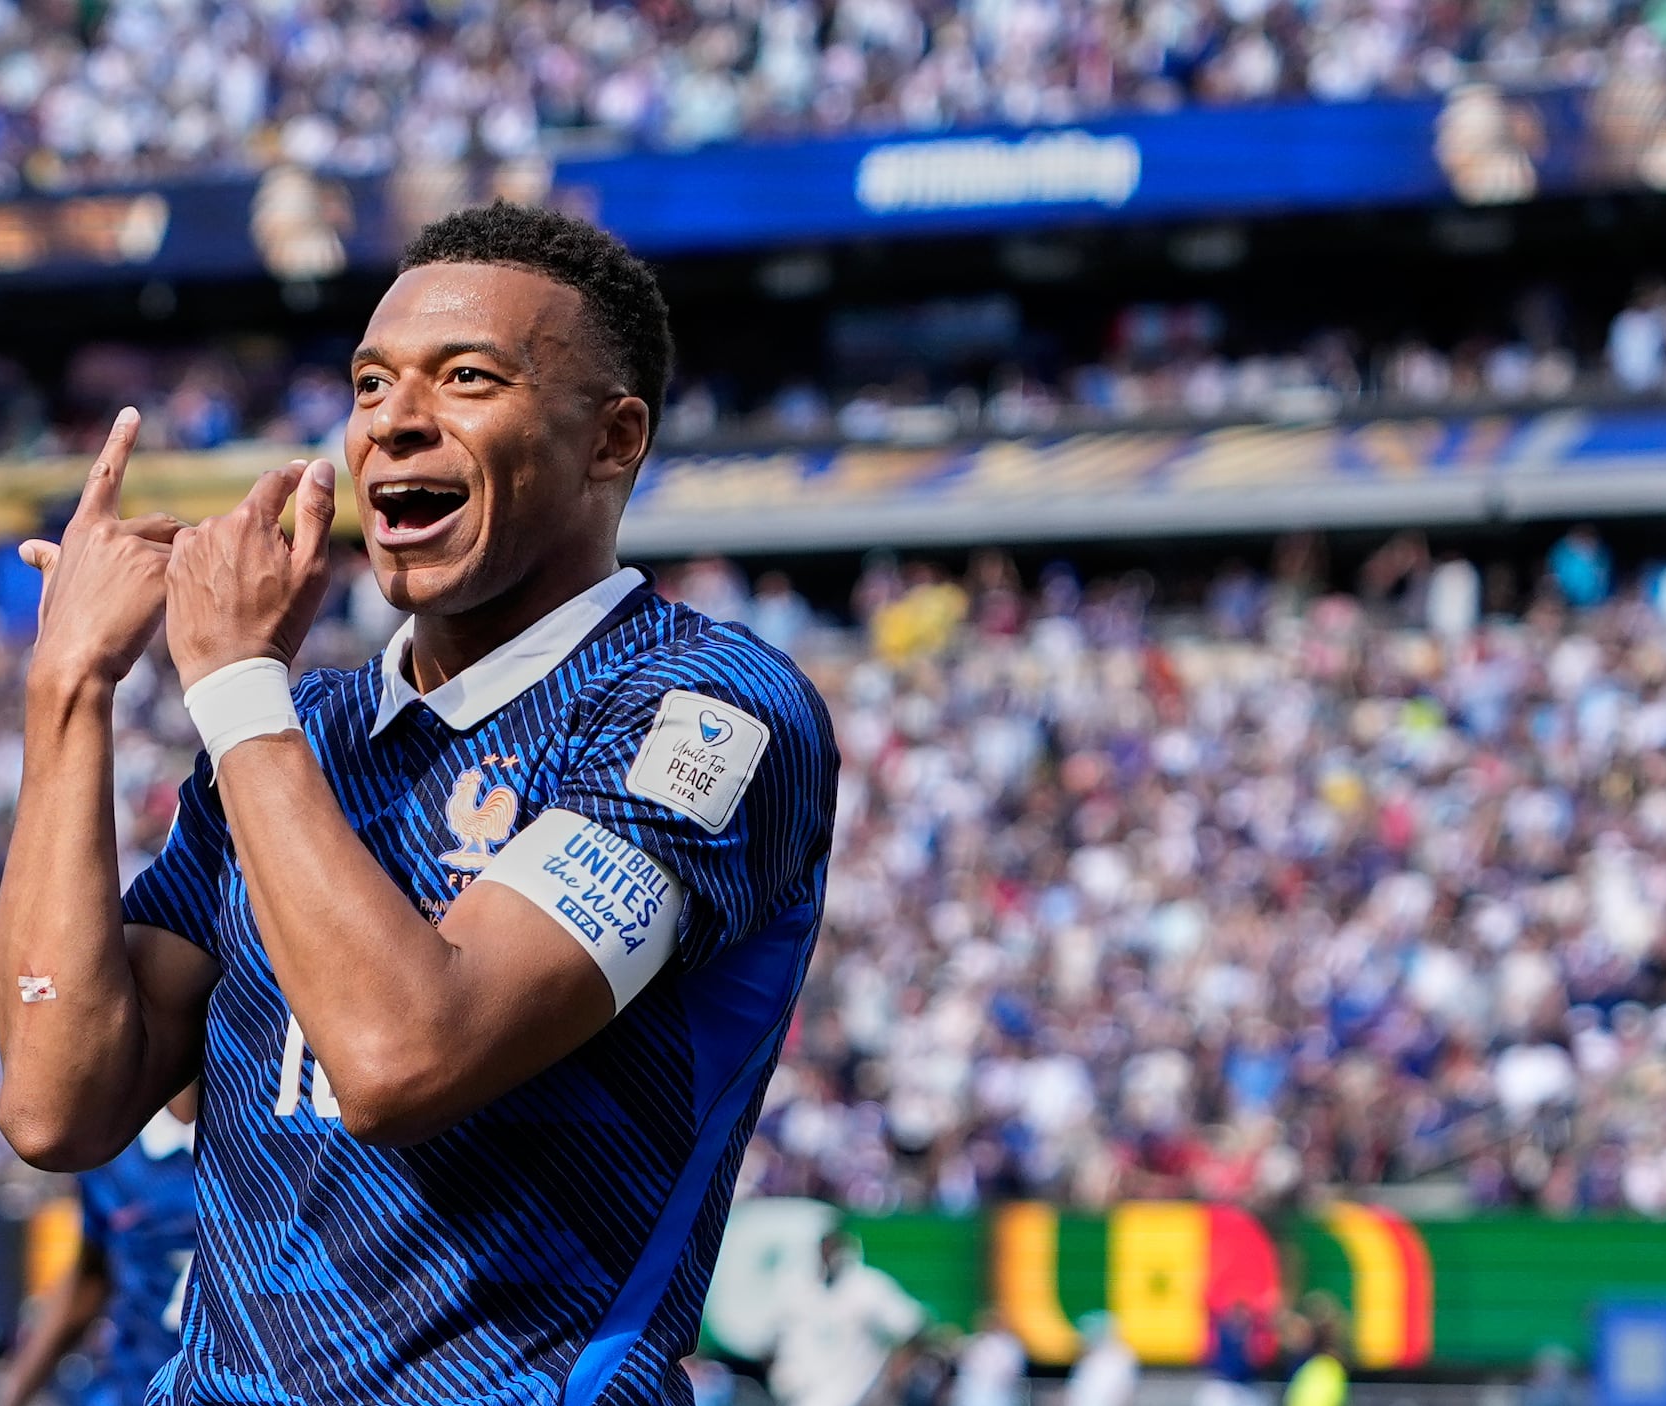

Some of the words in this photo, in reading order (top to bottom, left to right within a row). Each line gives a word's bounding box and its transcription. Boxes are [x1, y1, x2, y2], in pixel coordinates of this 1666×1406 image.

[673, 738, 708, 763] Unite
[707, 754, 728, 775] For
[666, 758, 718, 796] PEACE
[669, 783, 696, 803] FIFA
[448, 873, 472, 889] FF
[564, 833, 658, 929] UNITES
[419, 897, 448, 913] FRAN
[542, 854, 581, 889] the
[581, 883, 646, 956] World
[560, 899, 600, 940] FIFA
